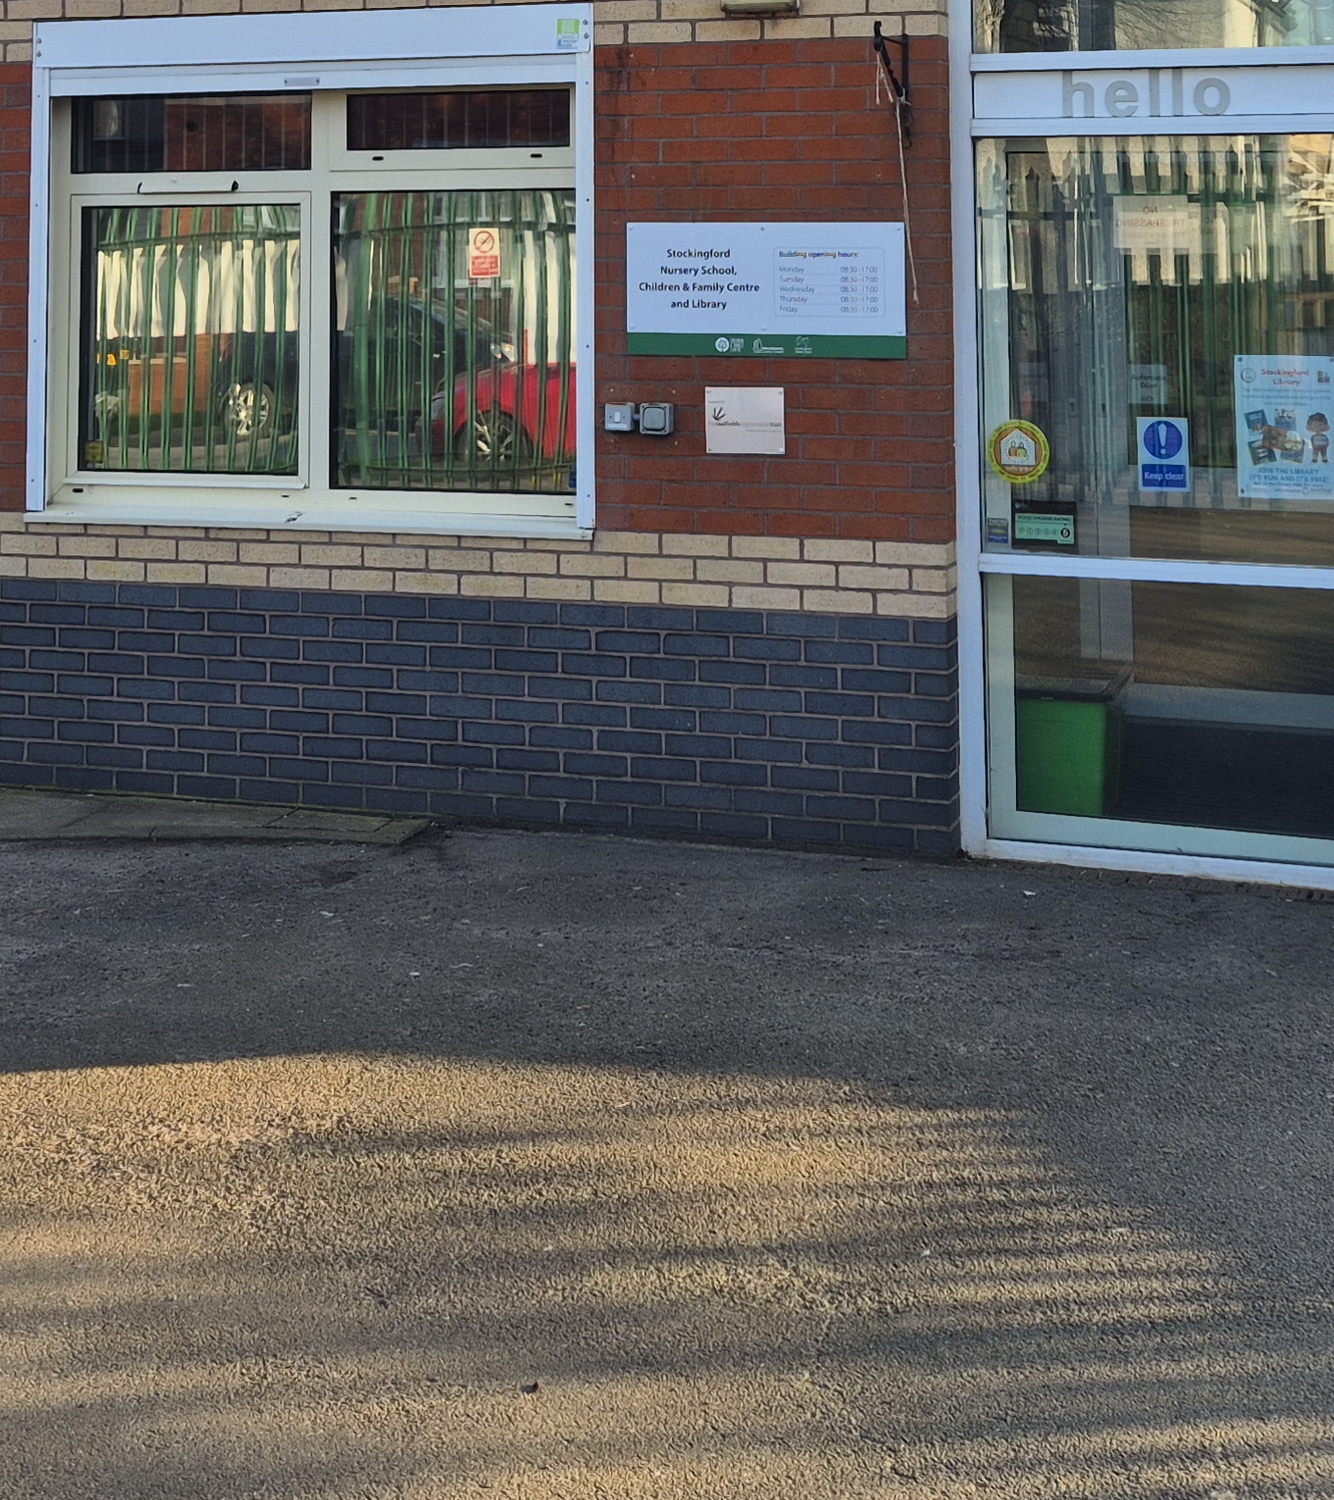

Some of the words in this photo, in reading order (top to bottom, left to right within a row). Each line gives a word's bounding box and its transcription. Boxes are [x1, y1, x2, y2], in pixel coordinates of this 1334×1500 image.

[1062, 68, 1231, 118] hello
[667, 249, 731, 260] Stockingford
[660, 266, 699, 277] Nursery
[701, 266, 737, 276] School,
[779, 266, 804, 274] Monday
[639, 282, 680, 291] Children
[682, 283, 689, 291] &
[692, 282, 724, 294] Family
[727, 283, 760, 292] Centre
[670, 299, 689, 308] and
[692, 299, 727, 311] Library
[780, 306, 798, 314] Friday
[1261, 368, 1309, 377] Stockingford
[1144, 471, 1163, 481] Keep
[1165, 471, 1185, 480] clear
